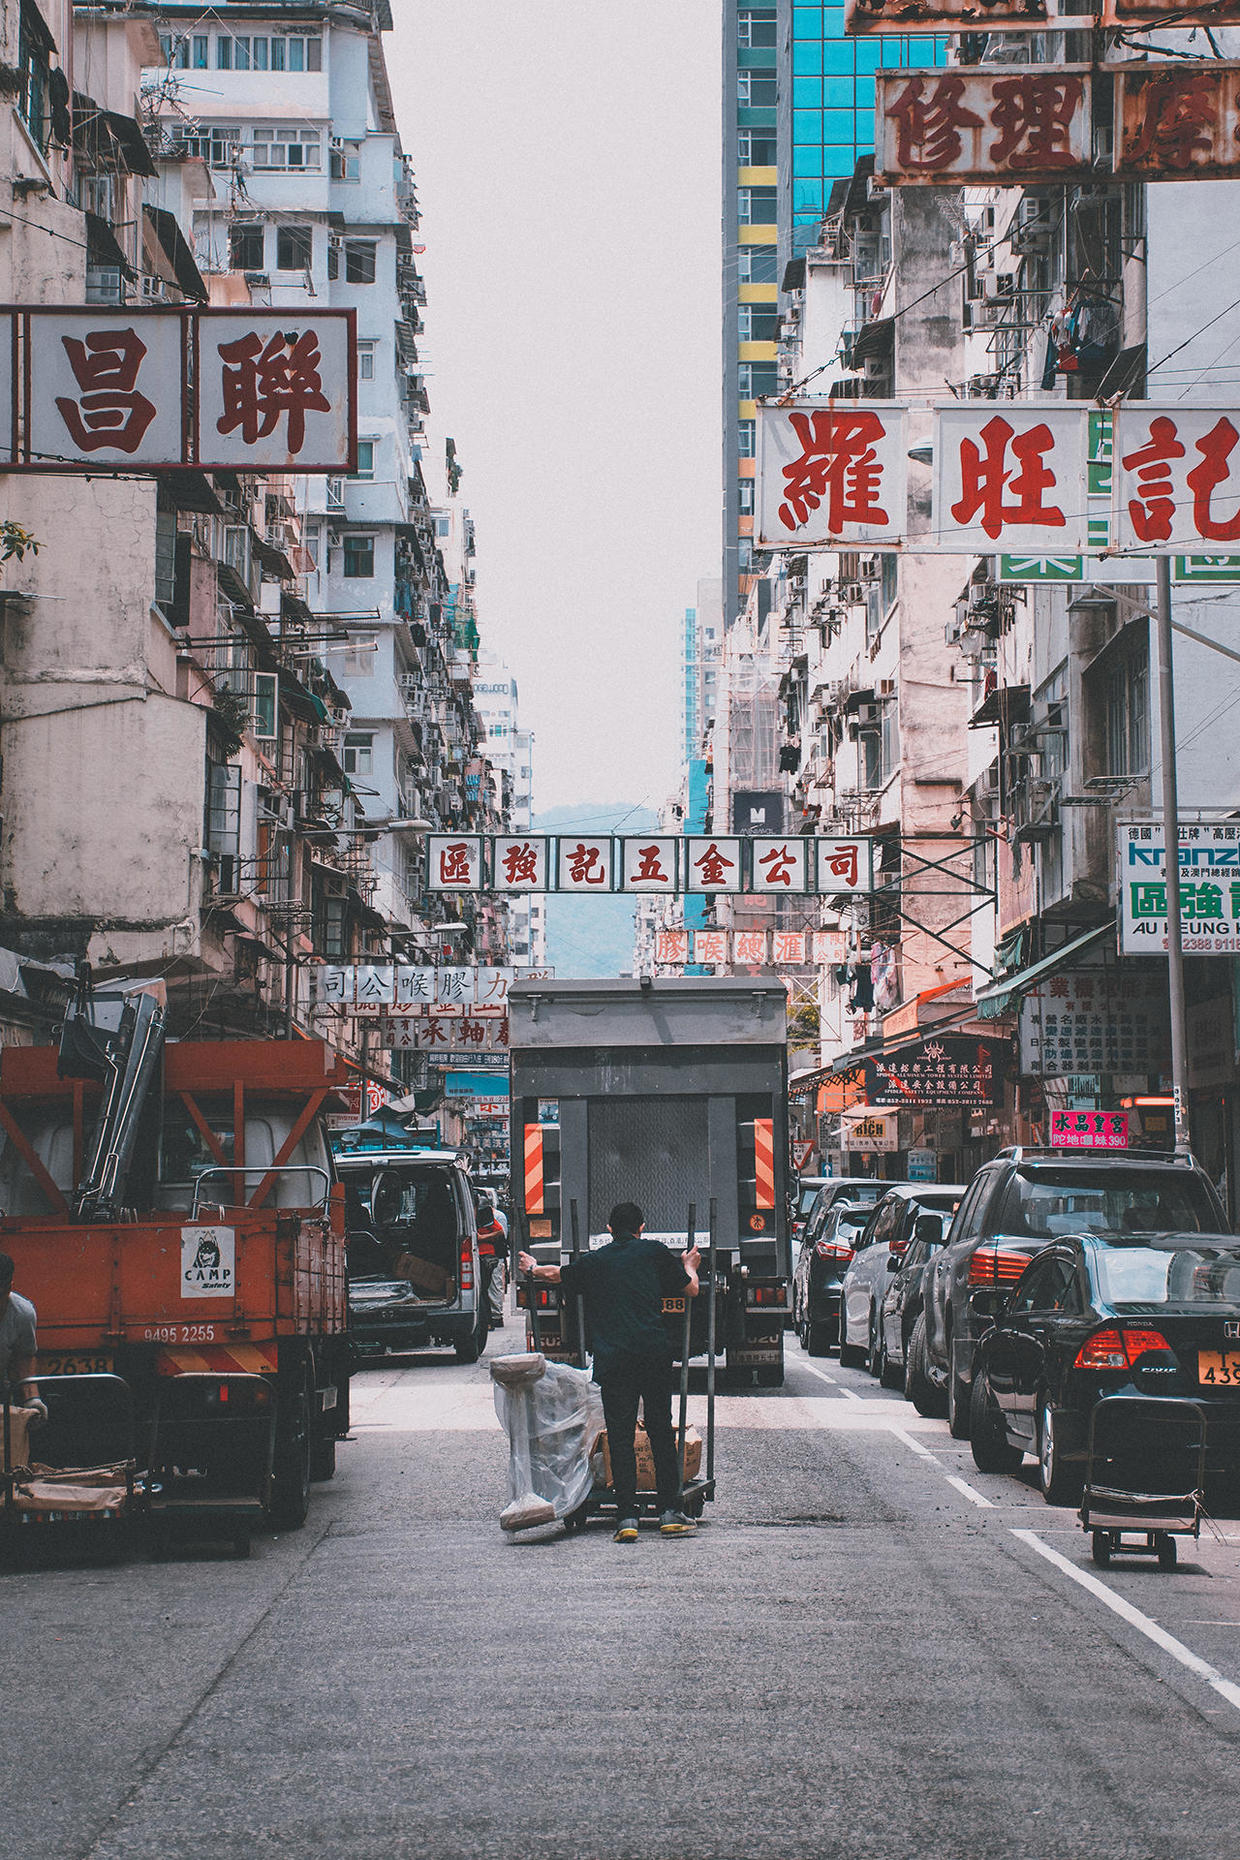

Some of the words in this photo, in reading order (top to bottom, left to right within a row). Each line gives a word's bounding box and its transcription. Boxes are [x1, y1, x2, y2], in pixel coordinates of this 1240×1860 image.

[440, 843, 859, 887] 區強記五金公司
[1133, 922, 1157, 934] AU
[1164, 922, 1229, 934] EUNG
[1183, 939, 1212, 950] 2388
[1055, 1113, 1125, 1133] 水晶皇宮
[184, 1269, 231, 1281] CAMP
[664, 1299, 684, 1310] 88
[144, 1327, 177, 1343] 9495
[181, 1325, 215, 1342] 2255
